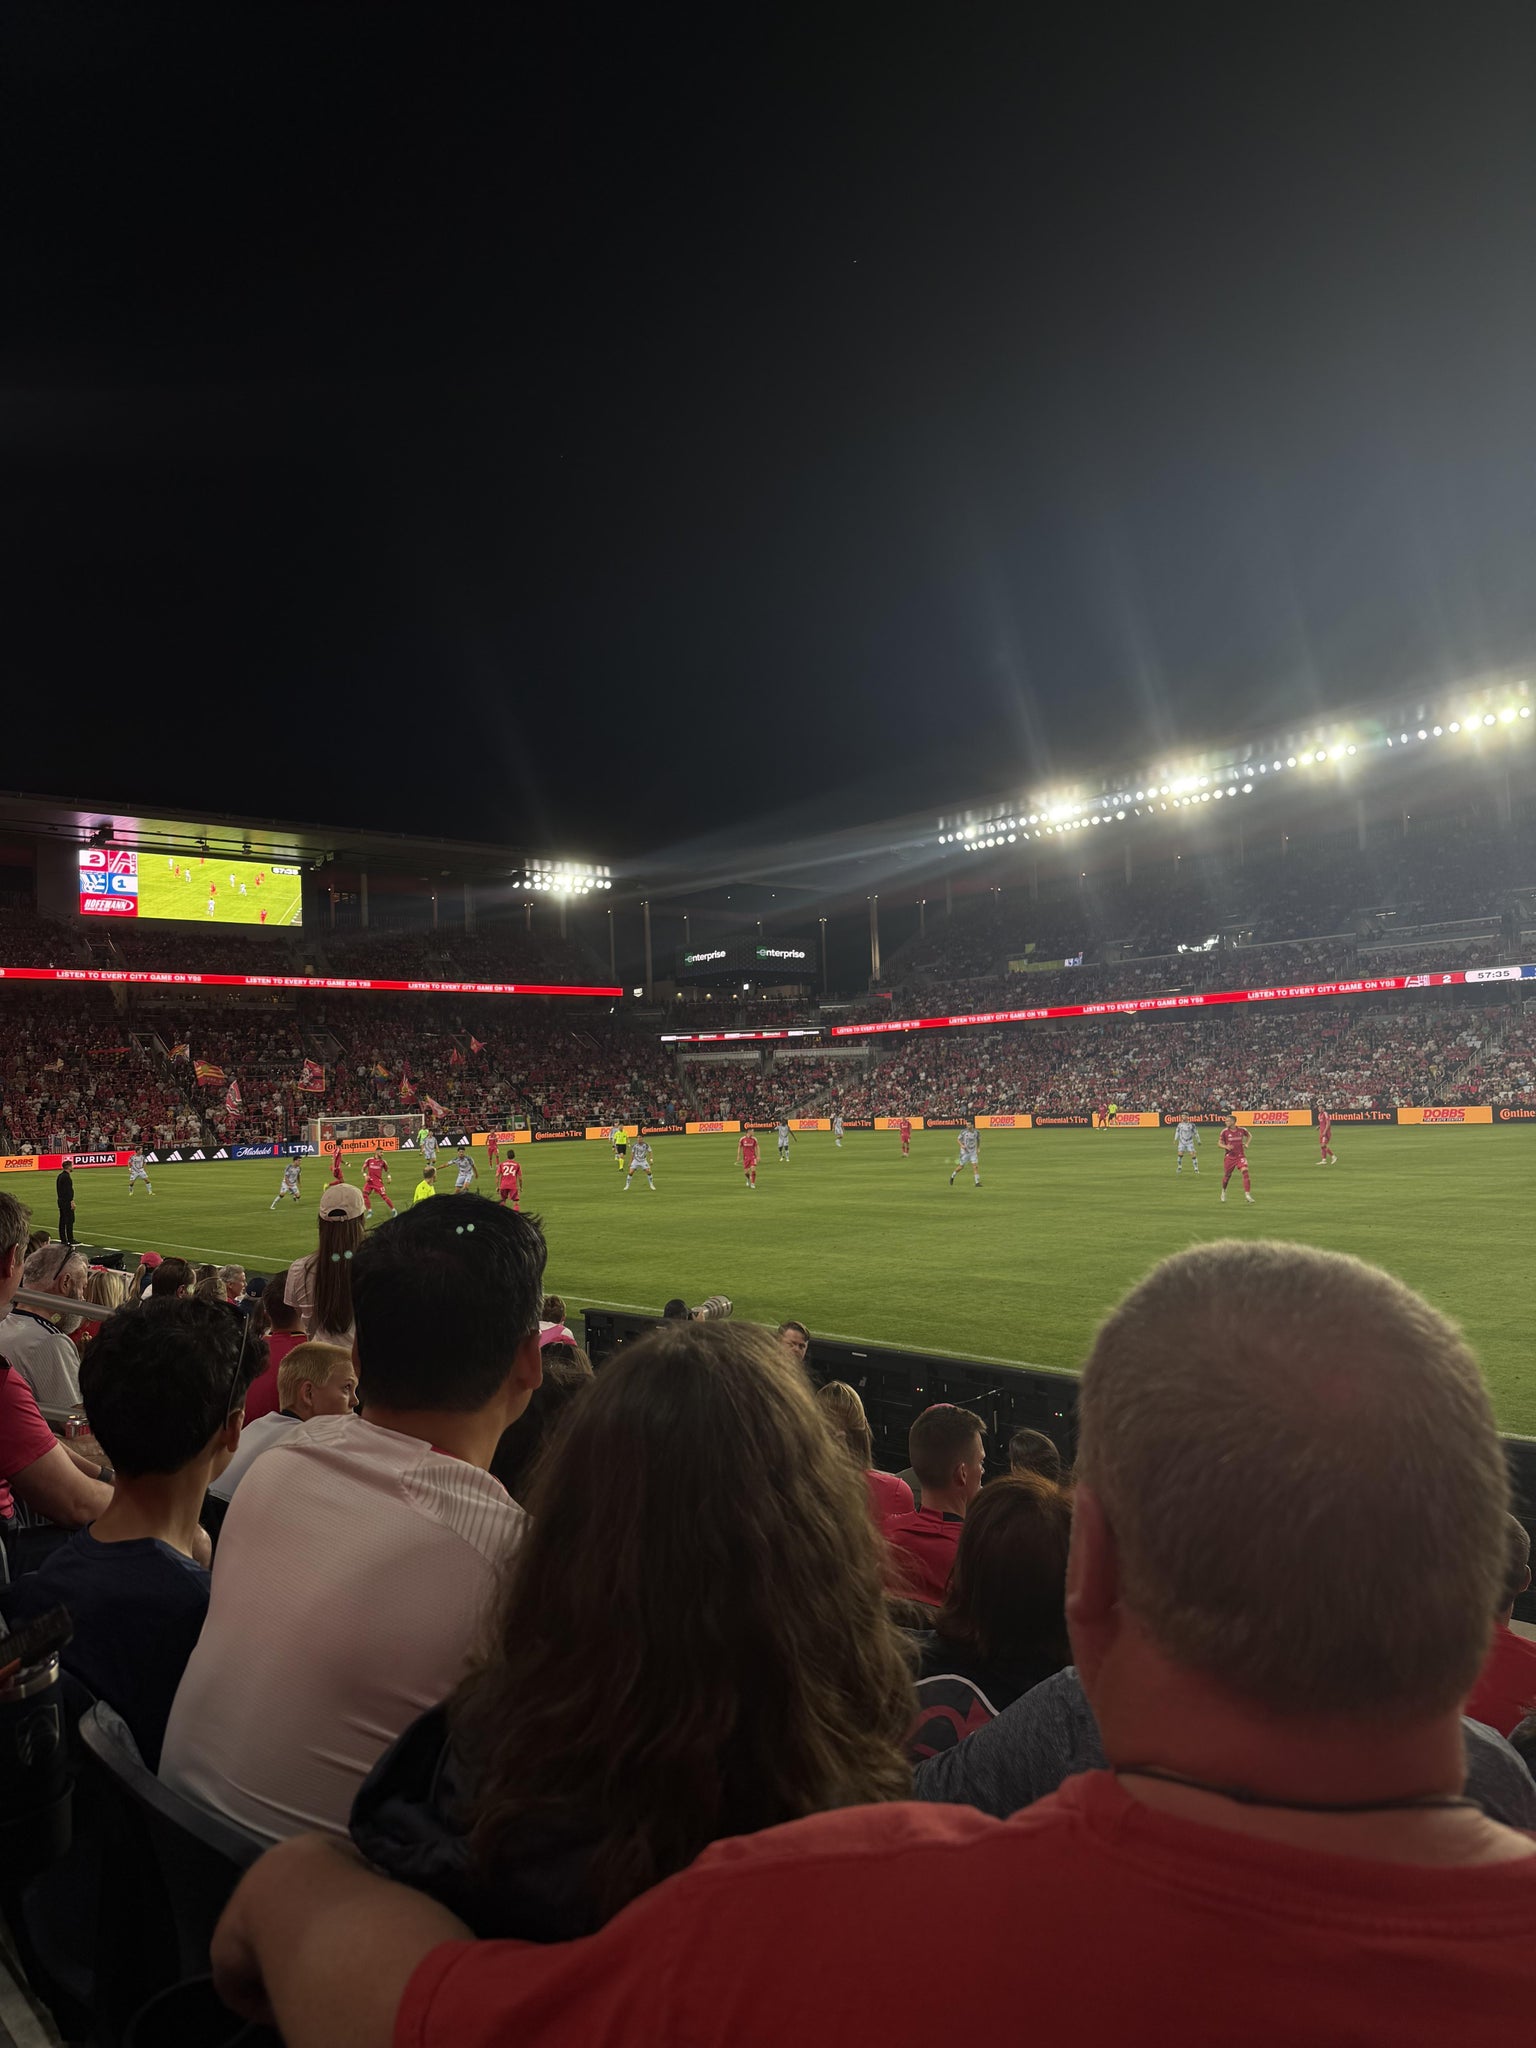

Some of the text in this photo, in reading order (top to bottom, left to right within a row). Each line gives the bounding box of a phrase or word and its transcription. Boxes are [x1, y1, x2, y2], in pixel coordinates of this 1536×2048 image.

[90, 854, 100, 864] 2
[117, 880, 126, 889] 1
[84, 899, 127, 910] HOFFMANN
[687, 950, 726, 963] enterprise
[758, 949, 805, 959] enterprise
[101, 972, 128, 980] EVERY
[1442, 971, 1510, 984] 2 57:35
[1247, 991, 1275, 999] LISTEN
[1276, 989, 1287, 997] TO
[1289, 987, 1315, 996] EVERY
[1317, 985, 1337, 993] CITY
[1339, 983, 1362, 991] GAME
[1116, 1114, 1140, 1122] OBBS
[1253, 1112, 1289, 1121] DOBBS
[1370, 1111, 1392, 1120] Tire
[1423, 1108, 1465, 1118] DOBBS
[926, 1118, 956, 1128] Continental
[990, 1116, 1015, 1124] DOBBS
[1035, 1115, 1089, 1126] Continental Tire
[641, 1124, 683, 1135] Continental Tire
[743, 1121, 772, 1130] Continental
[535, 1130, 565, 1141] Continental
[324, 1140, 395, 1152] Coinental Tire
[236, 1146, 272, 1157] Michelob
[5, 1158, 34, 1166] DOBBS
[75, 1155, 112, 1164] PURINA
[502, 1165, 516, 1177] 24
